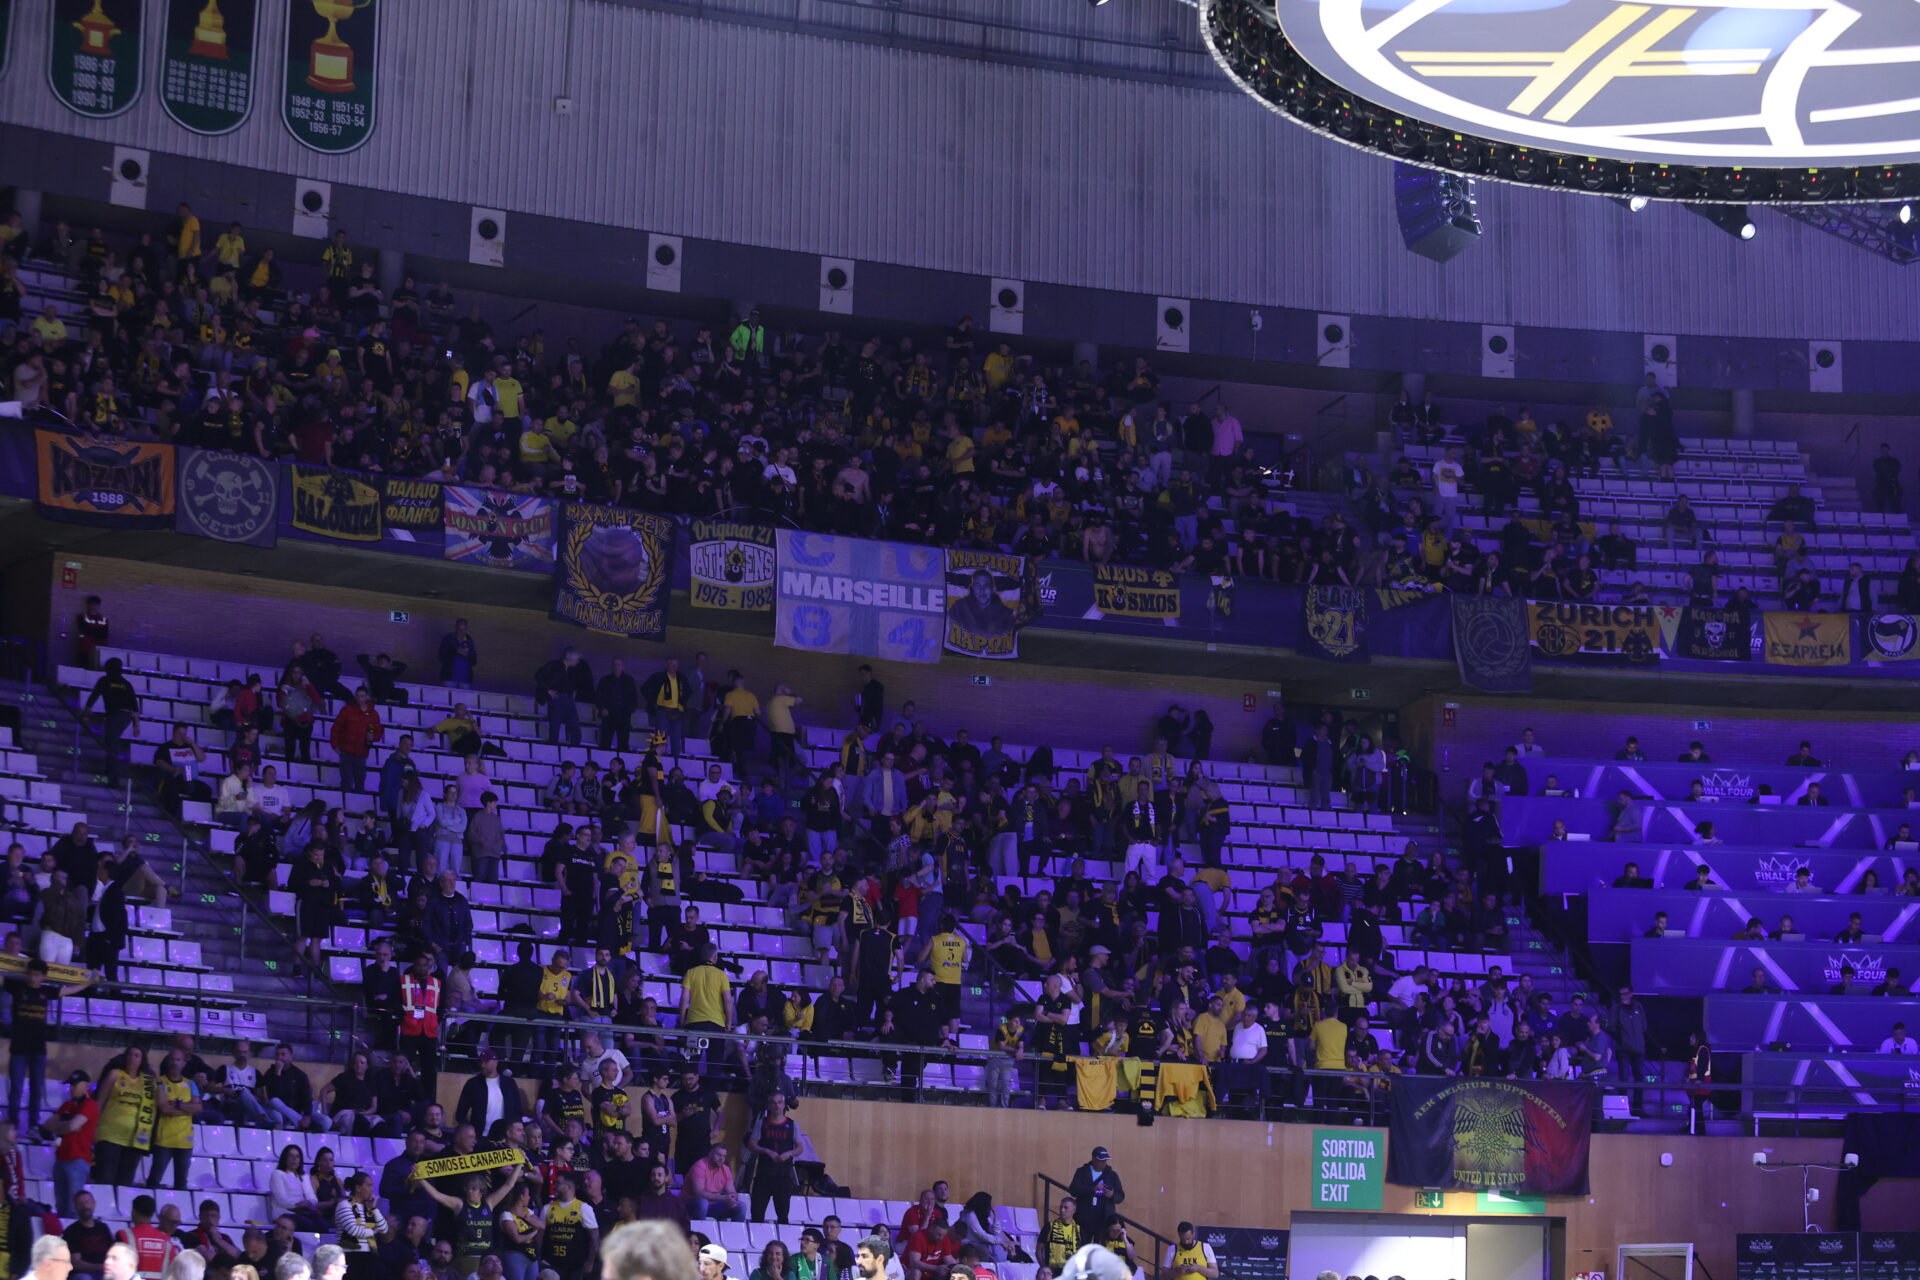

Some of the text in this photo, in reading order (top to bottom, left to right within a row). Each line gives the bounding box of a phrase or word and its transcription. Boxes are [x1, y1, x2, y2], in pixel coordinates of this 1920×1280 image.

[292, 95, 365, 115] 1948-49 1951-52
[291, 107, 365, 127] 1952-53 1953-54
[309, 121, 343, 136] 1956-57
[92, 492, 124, 505] 1988
[387, 480, 439, 499] ΠΑΛΑΙΟ
[199, 512, 257, 536] GETTO
[386, 505, 440, 524] ΦΑΛΗΡΟ
[512, 515, 549, 537] CLUB
[692, 520, 773, 544] Original 21
[696, 584, 728, 606] 1975
[740, 586, 773, 608] 1982
[782, 570, 944, 613] MARSEILLE
[1535, 602, 1655, 627] ZURICH
[792, 605, 935, 660] 8 4
[1322, 609, 1354, 647] 21
[1583, 630, 1616, 651] 21
[1703, 787, 1755, 796] INAL FOUR
[145, 832, 160, 842] 22
[1755, 871, 1814, 881] FINAL FOR
[200, 893, 216, 903] 20
[1857, 970, 1887, 980] FOUR
[970, 987, 982, 996] 19
[1413, 1081, 1568, 1129] AEK BELGIUM SUPPORTERS
[1321, 1138, 1375, 1159] SORTIDA
[425, 1149, 516, 1176] ¡SOMOS EL CANARIAS!
[1321, 1162, 1366, 1181] SALIDA
[1453, 1169, 1526, 1186] UNITED WE STAND
[1321, 1184, 1350, 1202] EXIT
[552, 1245, 567, 1257] 35
